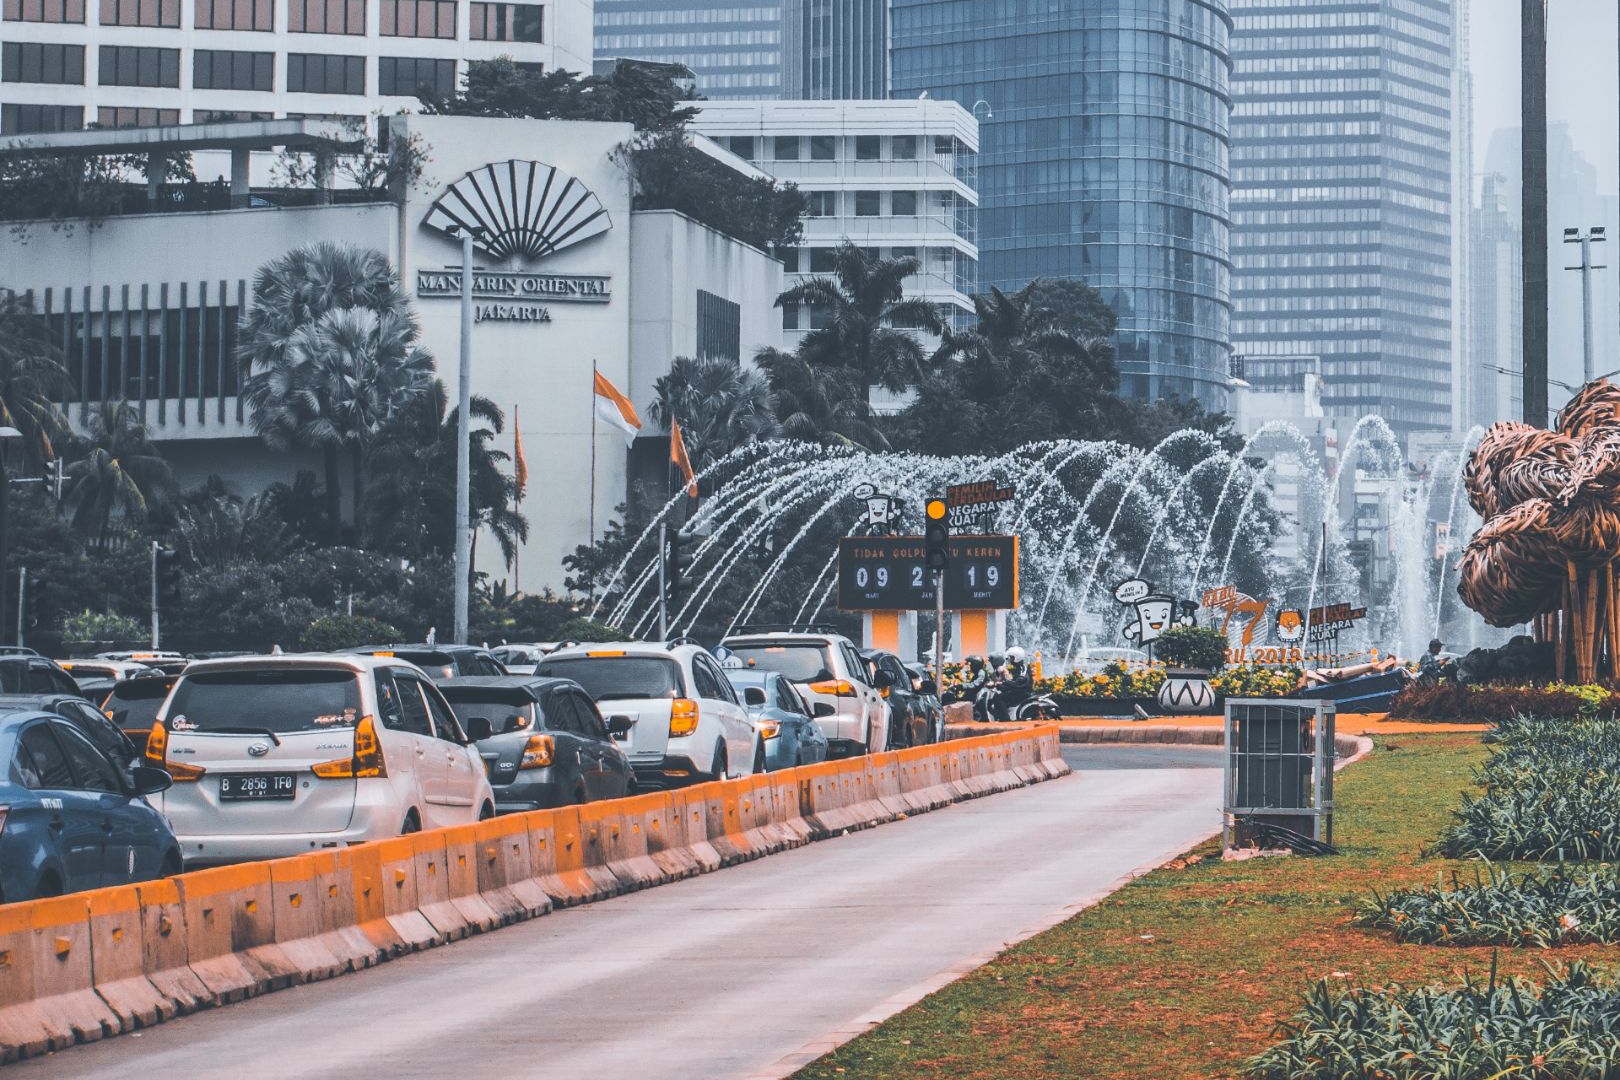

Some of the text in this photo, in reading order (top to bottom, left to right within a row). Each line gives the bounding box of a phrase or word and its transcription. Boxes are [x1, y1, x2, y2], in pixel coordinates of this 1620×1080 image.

[419, 275, 612, 294] MANARIN ORIENTAL
[475, 305, 552, 323] JAKARTA
[948, 503, 995, 517] NEGARA
[854, 548, 885, 558] TIDAK
[966, 547, 1001, 558] KEREN
[856, 567, 888, 588] 09
[967, 565, 999, 587] 19
[1202, 585, 1236, 608] RABU
[1221, 597, 1272, 647] 17
[1311, 620, 1351, 633] NEGARA
[1311, 629, 1336, 641] KUAT
[1254, 648, 1302, 665] 2019
[222, 778, 230, 791] B
[241, 778, 267, 791] 2856
